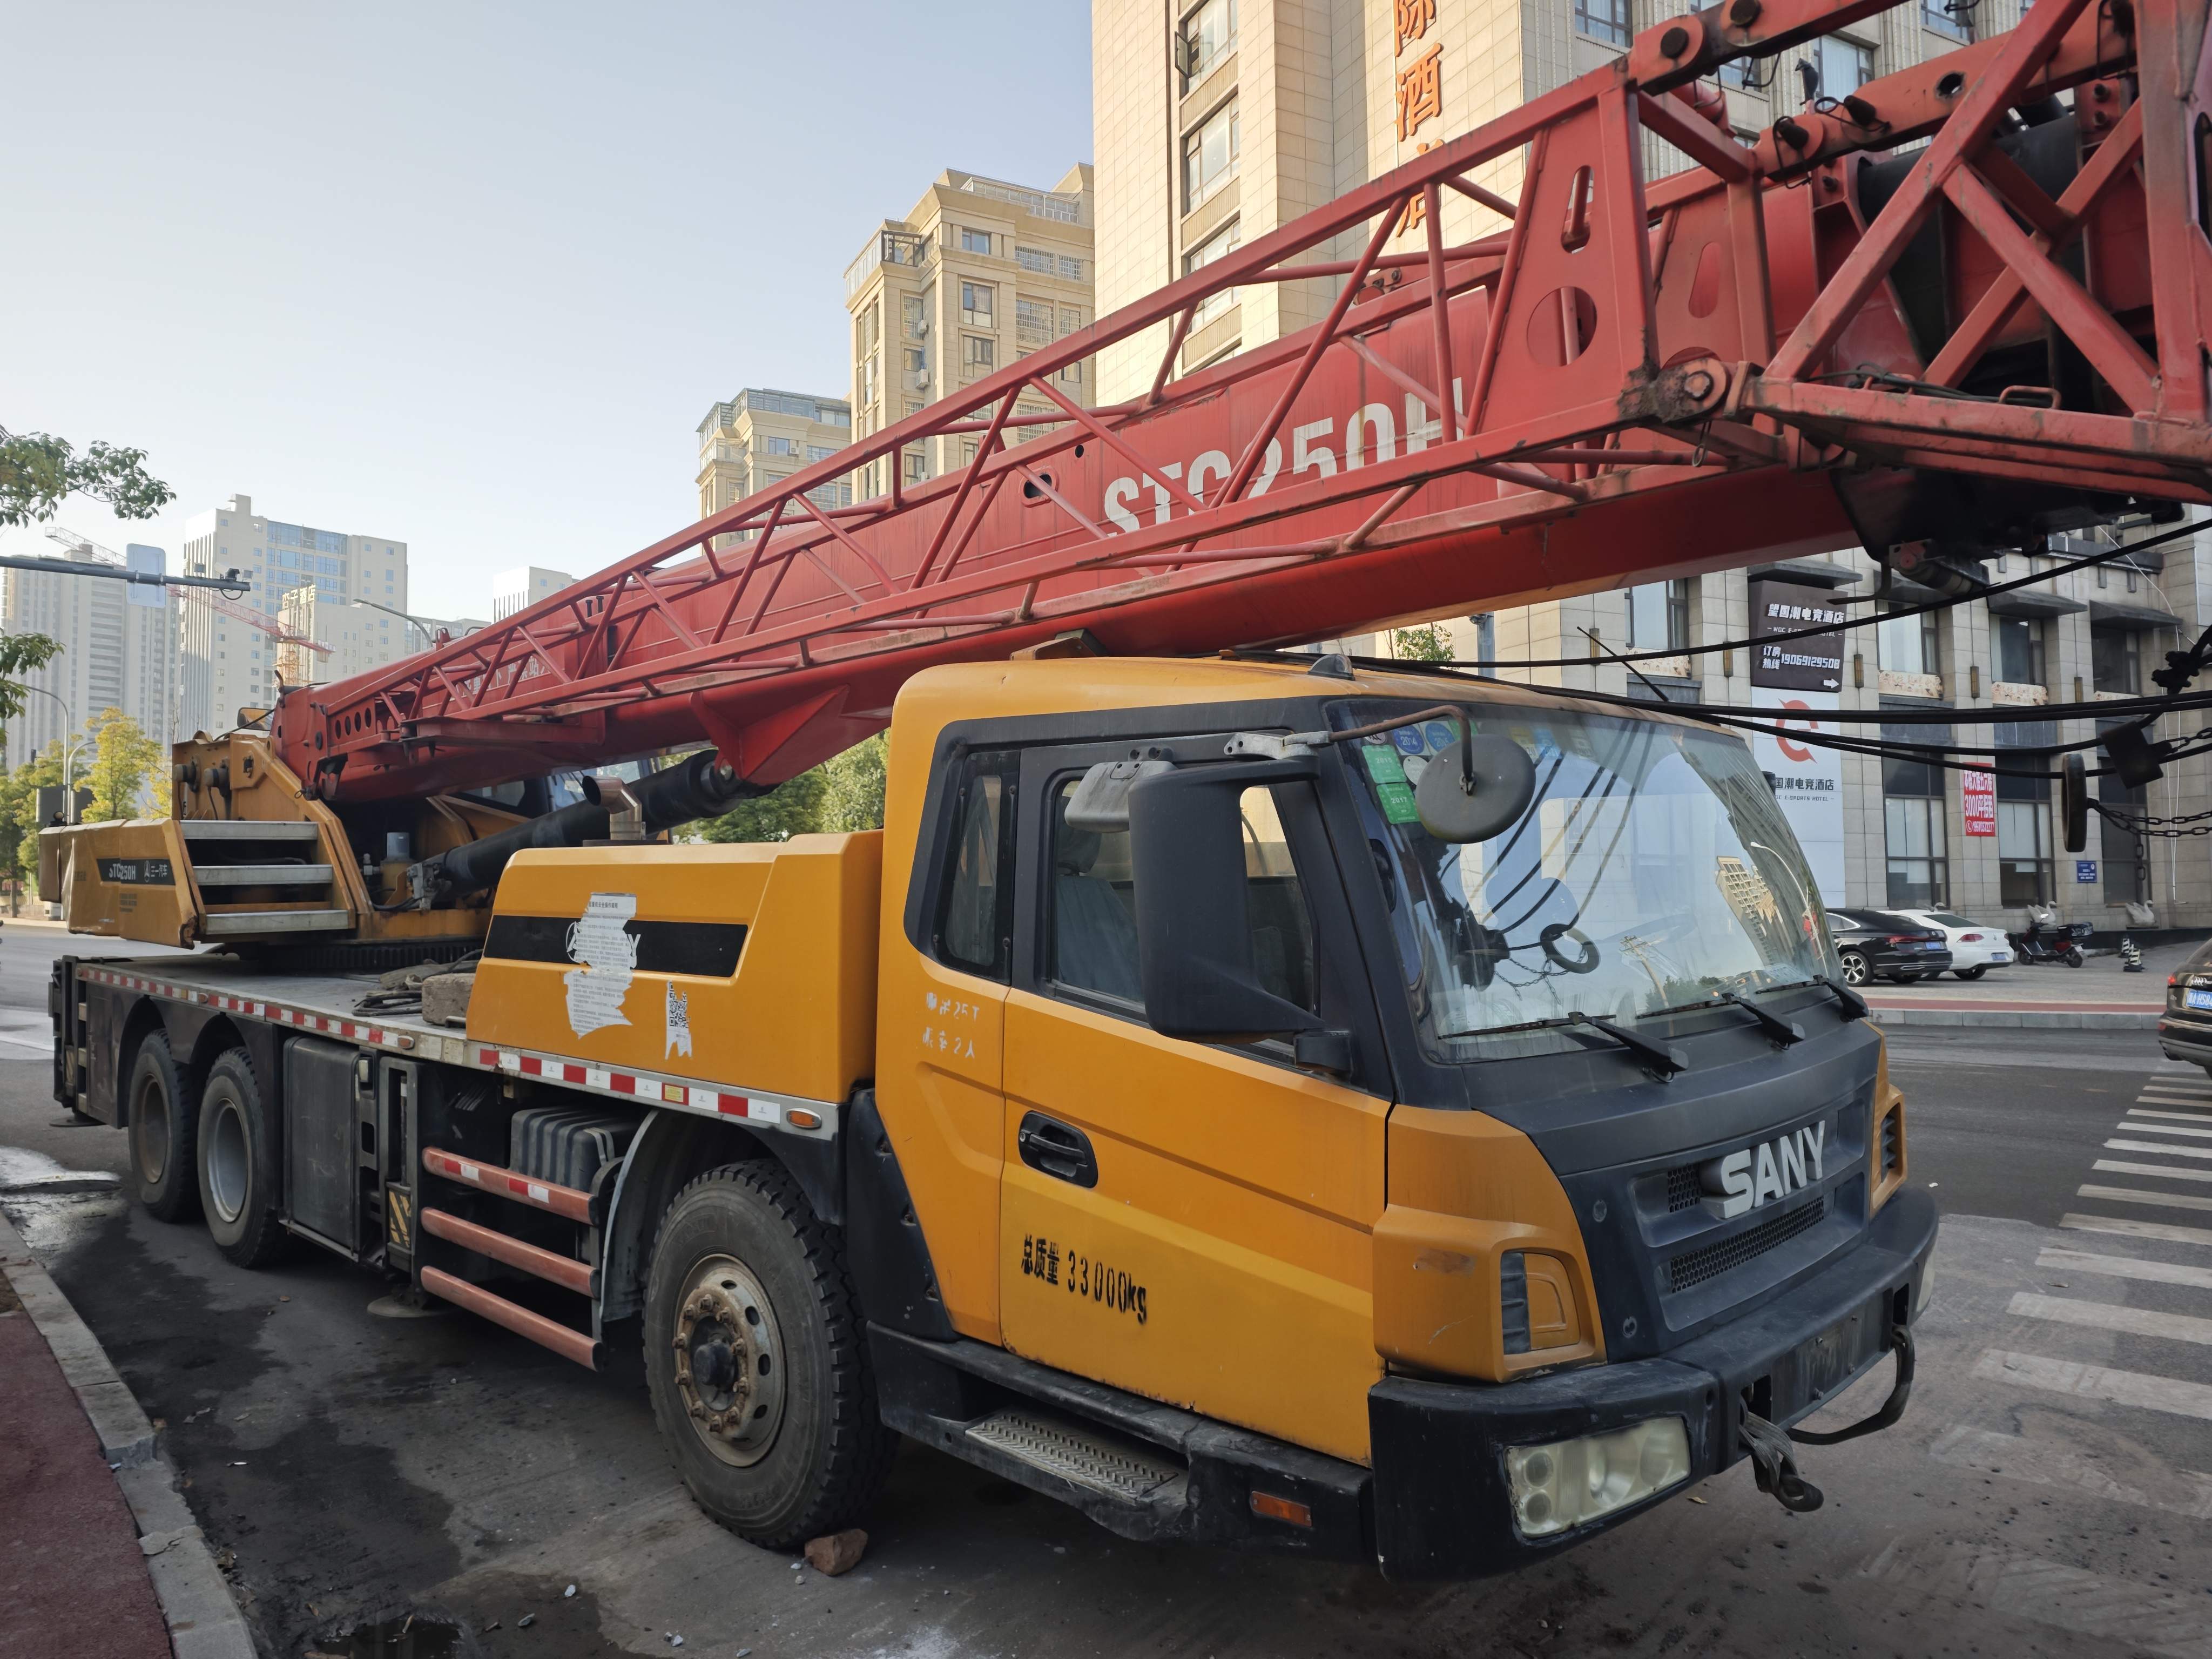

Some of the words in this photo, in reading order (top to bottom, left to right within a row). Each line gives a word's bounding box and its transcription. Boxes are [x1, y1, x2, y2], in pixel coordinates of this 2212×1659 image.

[1762, 658, 1781, 670] 热线
[1763, 645, 1782, 657] 订房
[1721, 1121, 1825, 1219] SANY
[1021, 1233, 1060, 1286] 总质量
[1067, 1249, 1147, 1325] 33000kg
